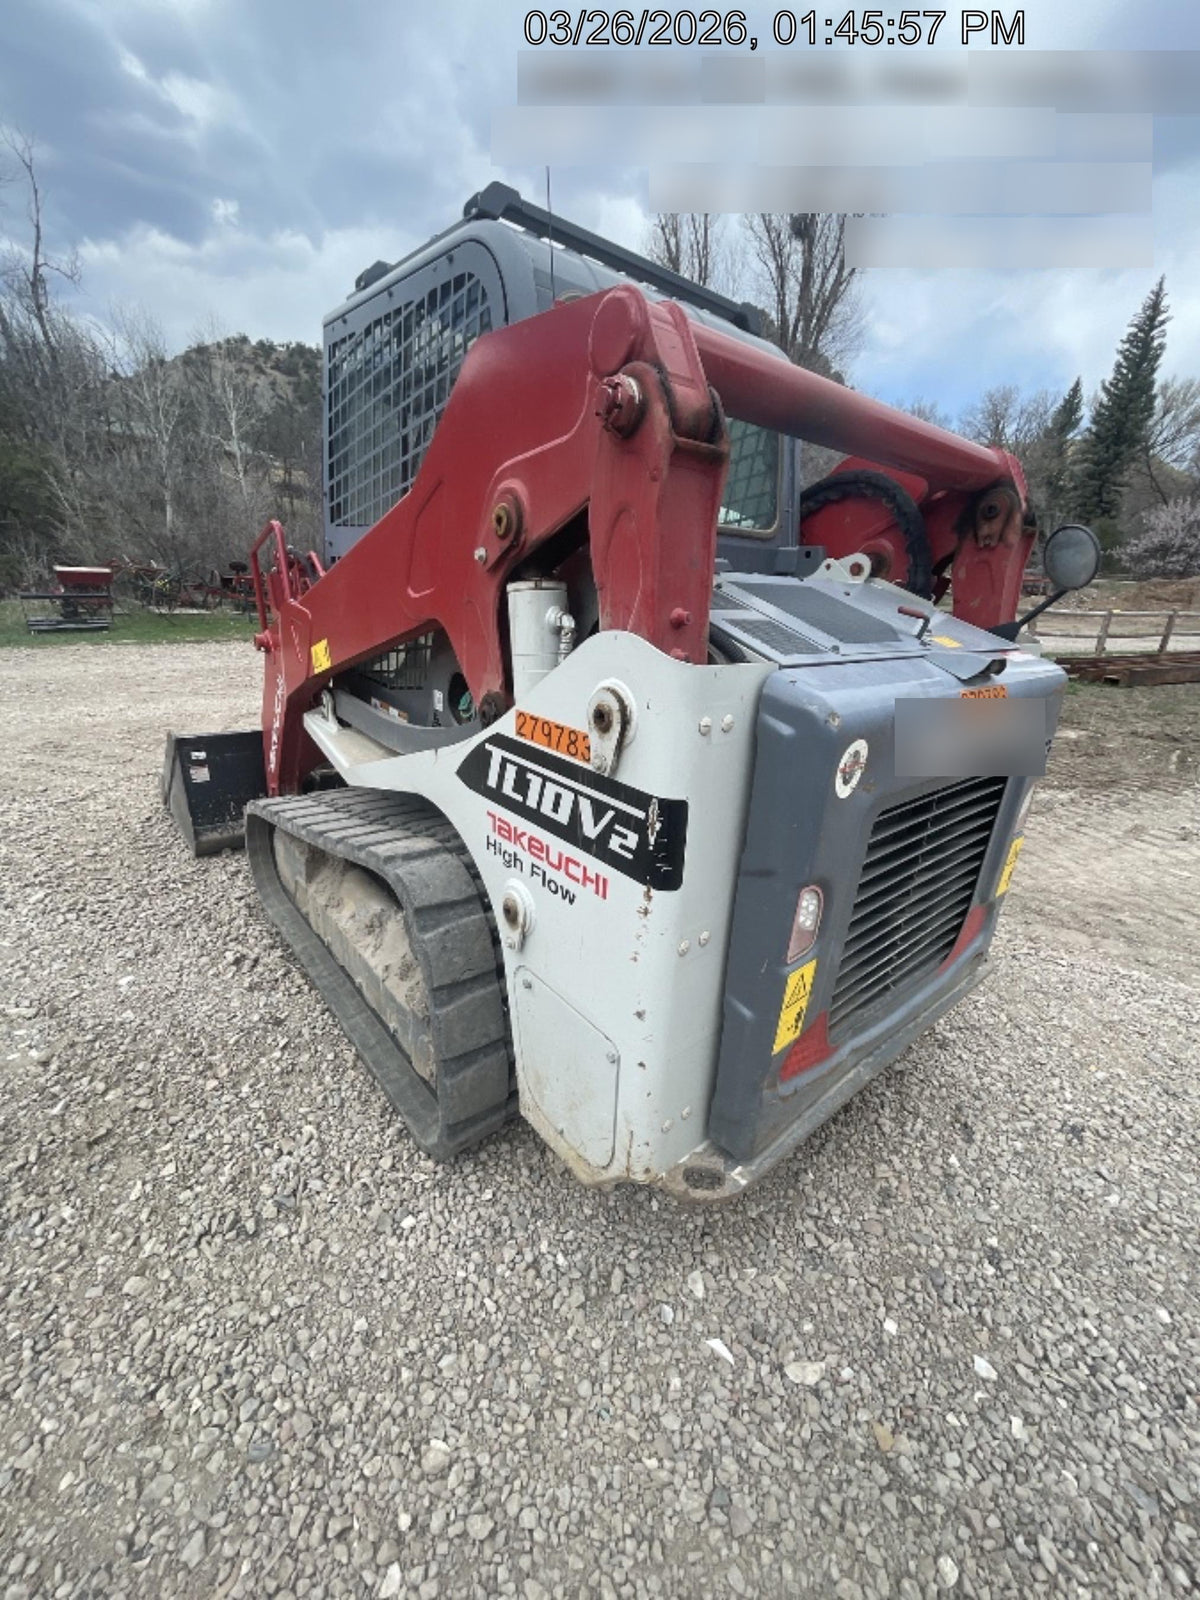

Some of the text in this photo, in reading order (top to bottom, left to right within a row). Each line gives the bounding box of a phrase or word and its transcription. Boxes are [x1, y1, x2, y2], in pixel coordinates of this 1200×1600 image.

[516, 711, 591, 762] 279783
[486, 835, 577, 906] High Flow
